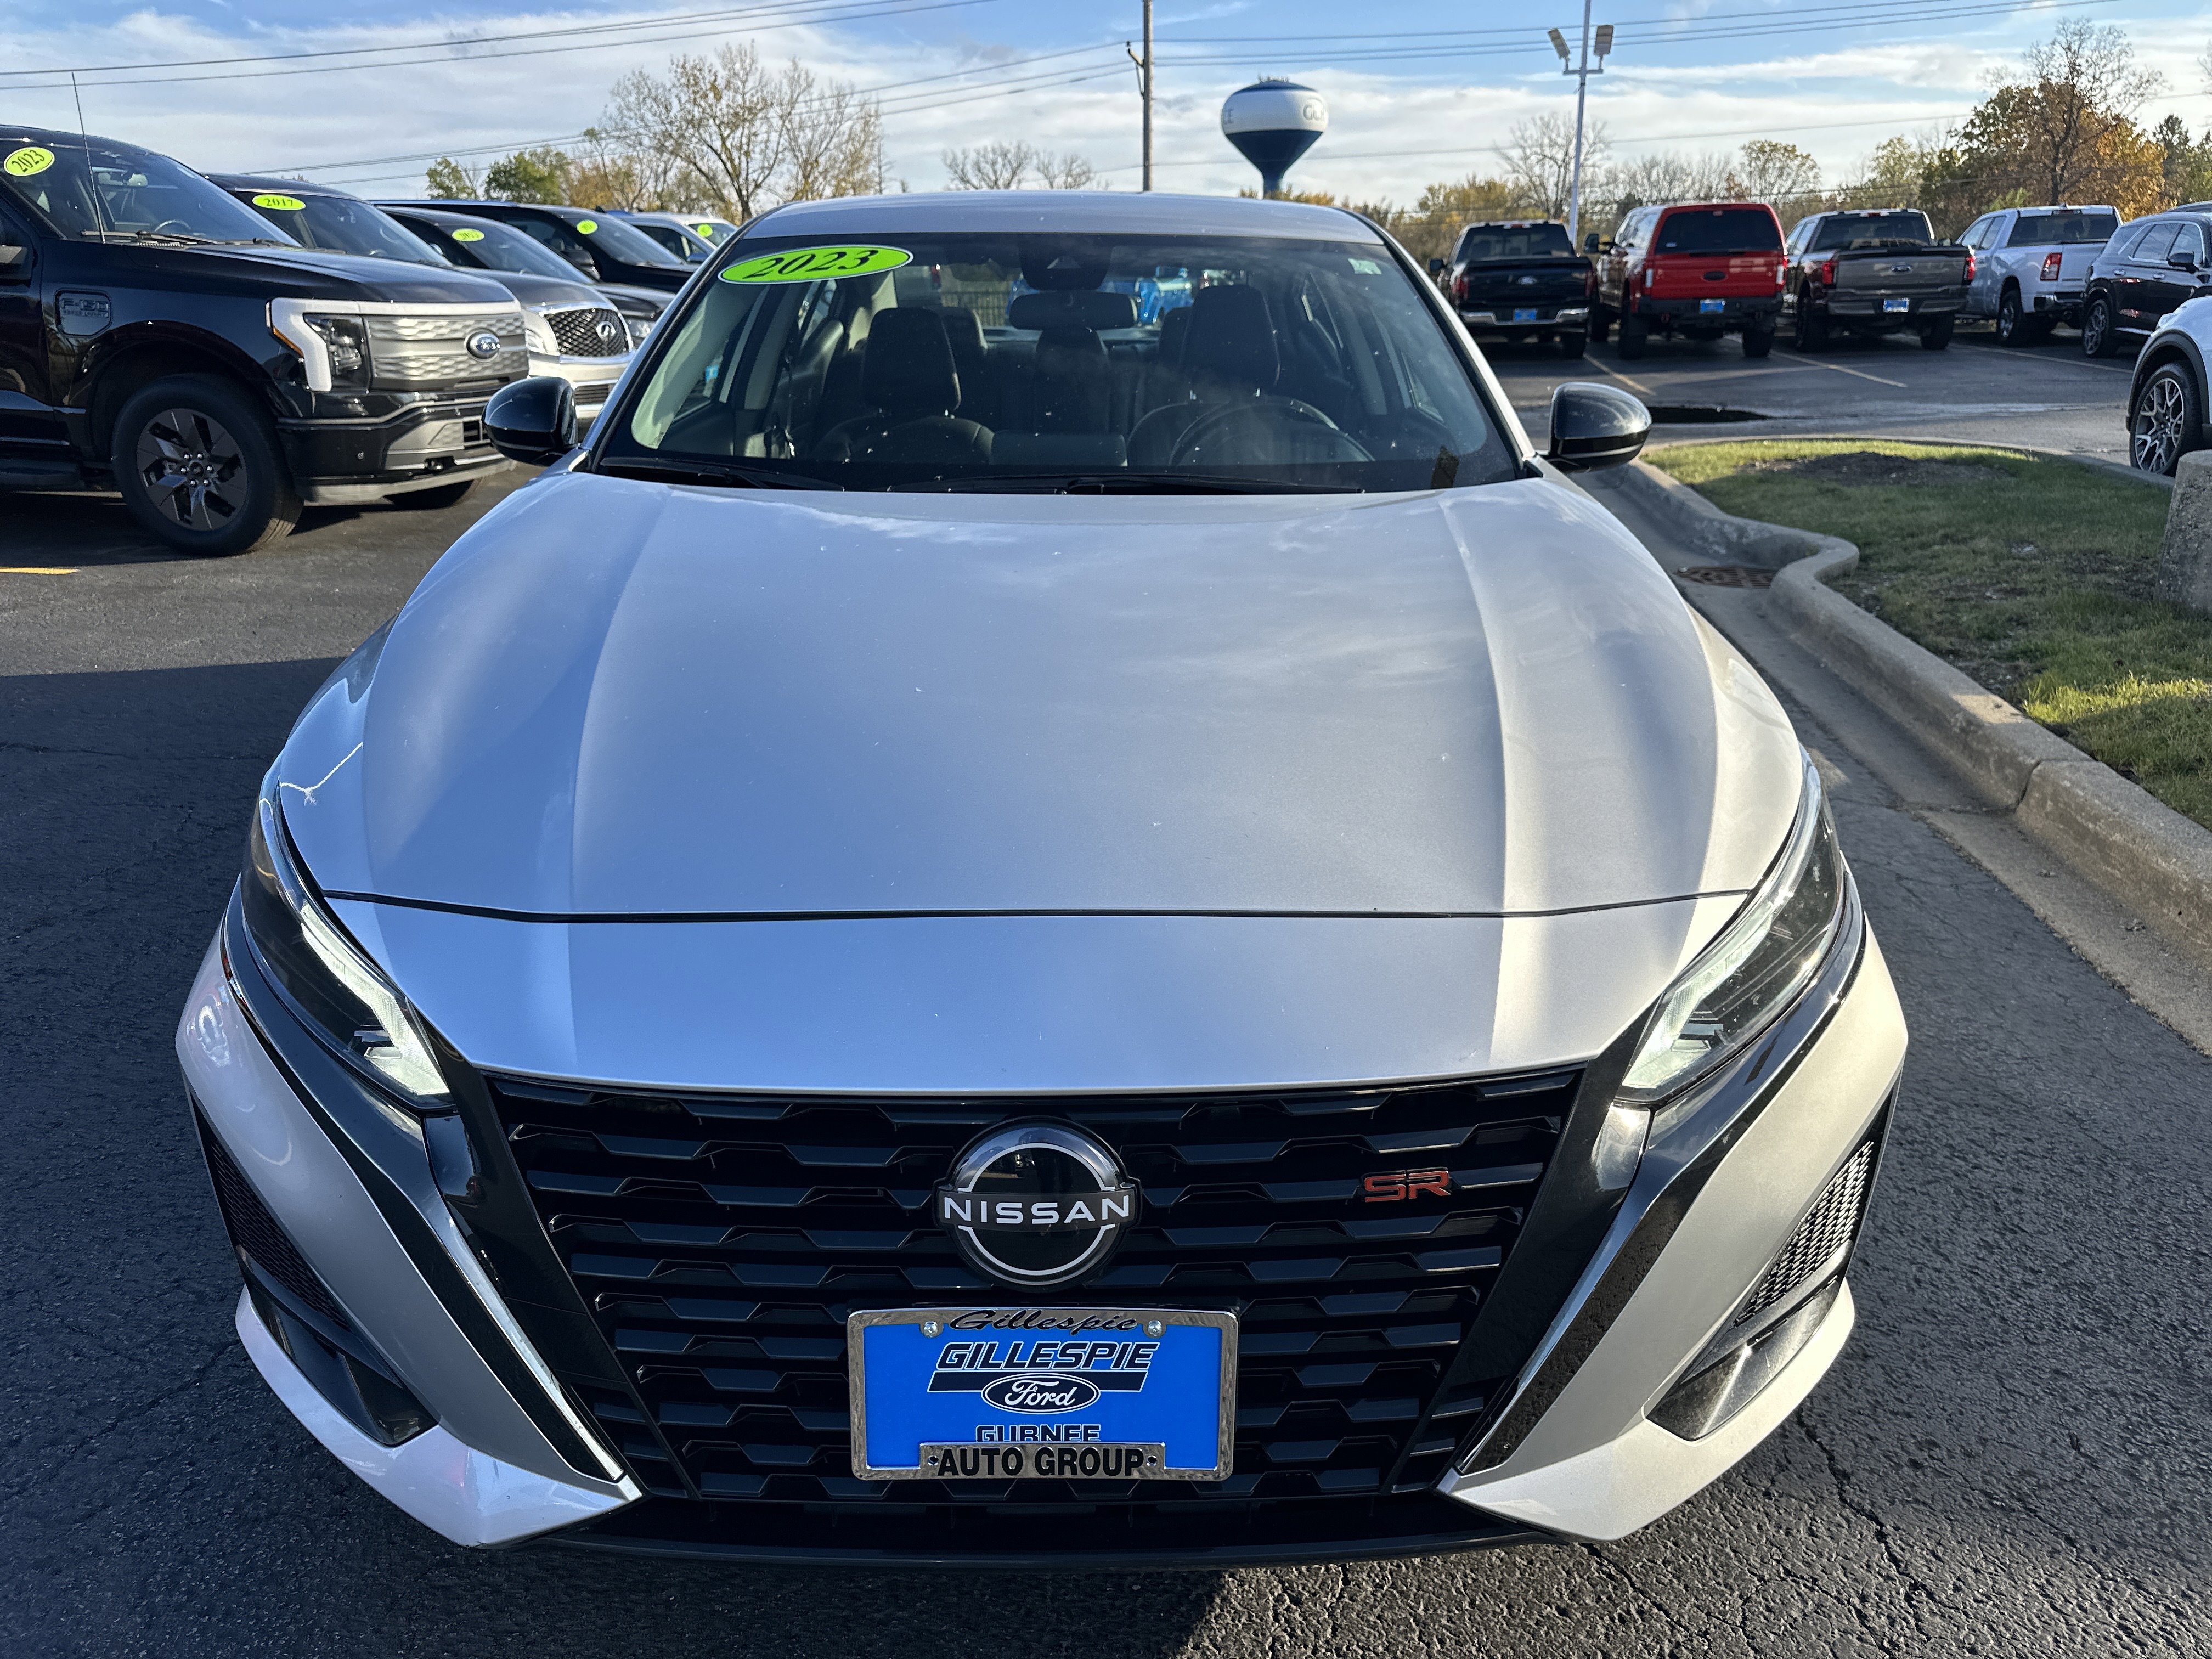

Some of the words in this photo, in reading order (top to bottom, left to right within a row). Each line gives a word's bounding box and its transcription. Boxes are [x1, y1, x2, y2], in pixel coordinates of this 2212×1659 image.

[11, 150, 45, 173] 2023
[742, 250, 879, 279] 2023
[1364, 1170, 1451, 1203] SR
[944, 1195, 1130, 1224] NISSAN
[950, 1309, 1138, 1335] Gillespie
[935, 1341, 1160, 1370] GILLESPIE
[1004, 1380, 1077, 1406] Ford
[936, 1447, 1024, 1476] AUTO
[1034, 1446, 1144, 1477] GROUP
